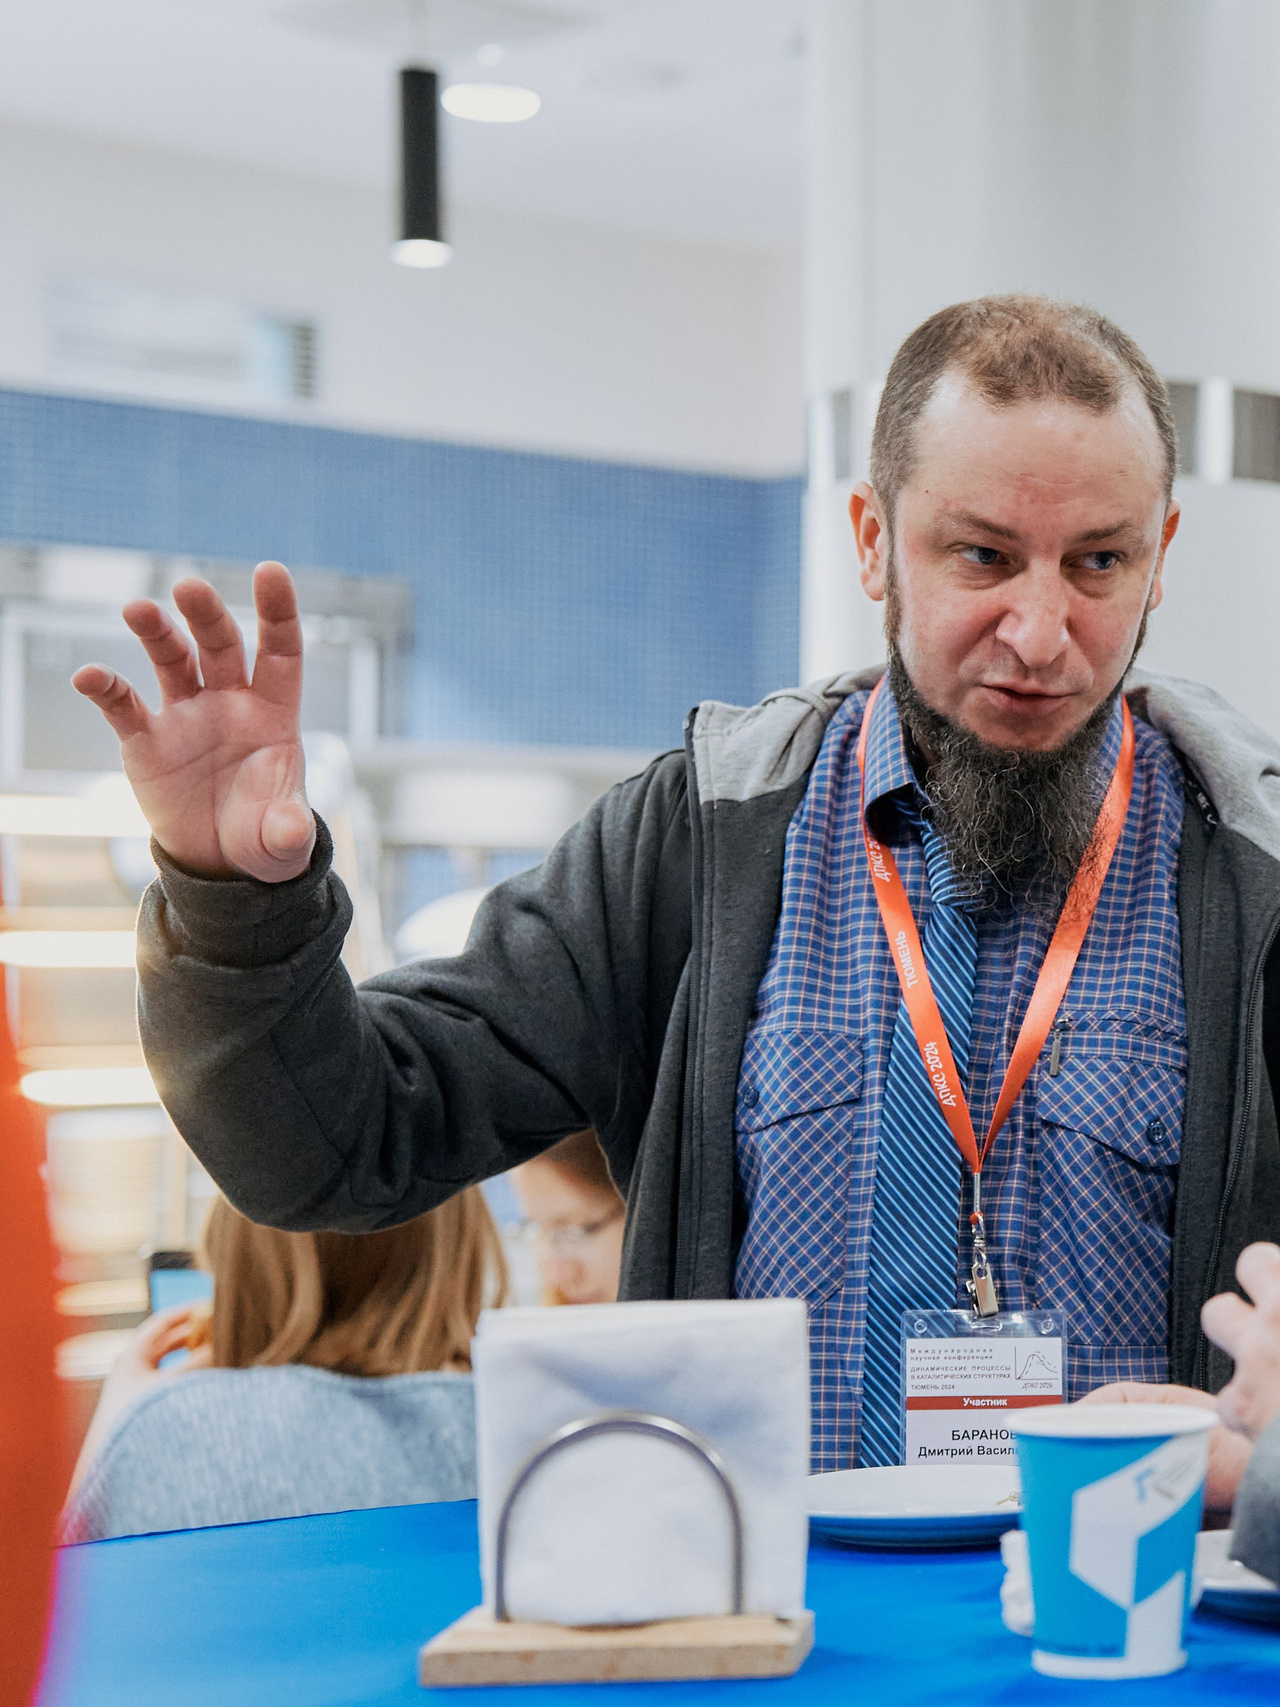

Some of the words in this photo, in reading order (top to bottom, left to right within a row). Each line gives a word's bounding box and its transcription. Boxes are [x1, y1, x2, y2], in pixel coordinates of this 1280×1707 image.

[894, 930, 918, 990] ТЮМЕНЬ
[923, 1041, 944, 1073] 2024
[932, 1071, 957, 1108] ДПКС
[962, 1397, 1008, 1407] Участник
[917, 1445, 973, 1459] Дмитрий
